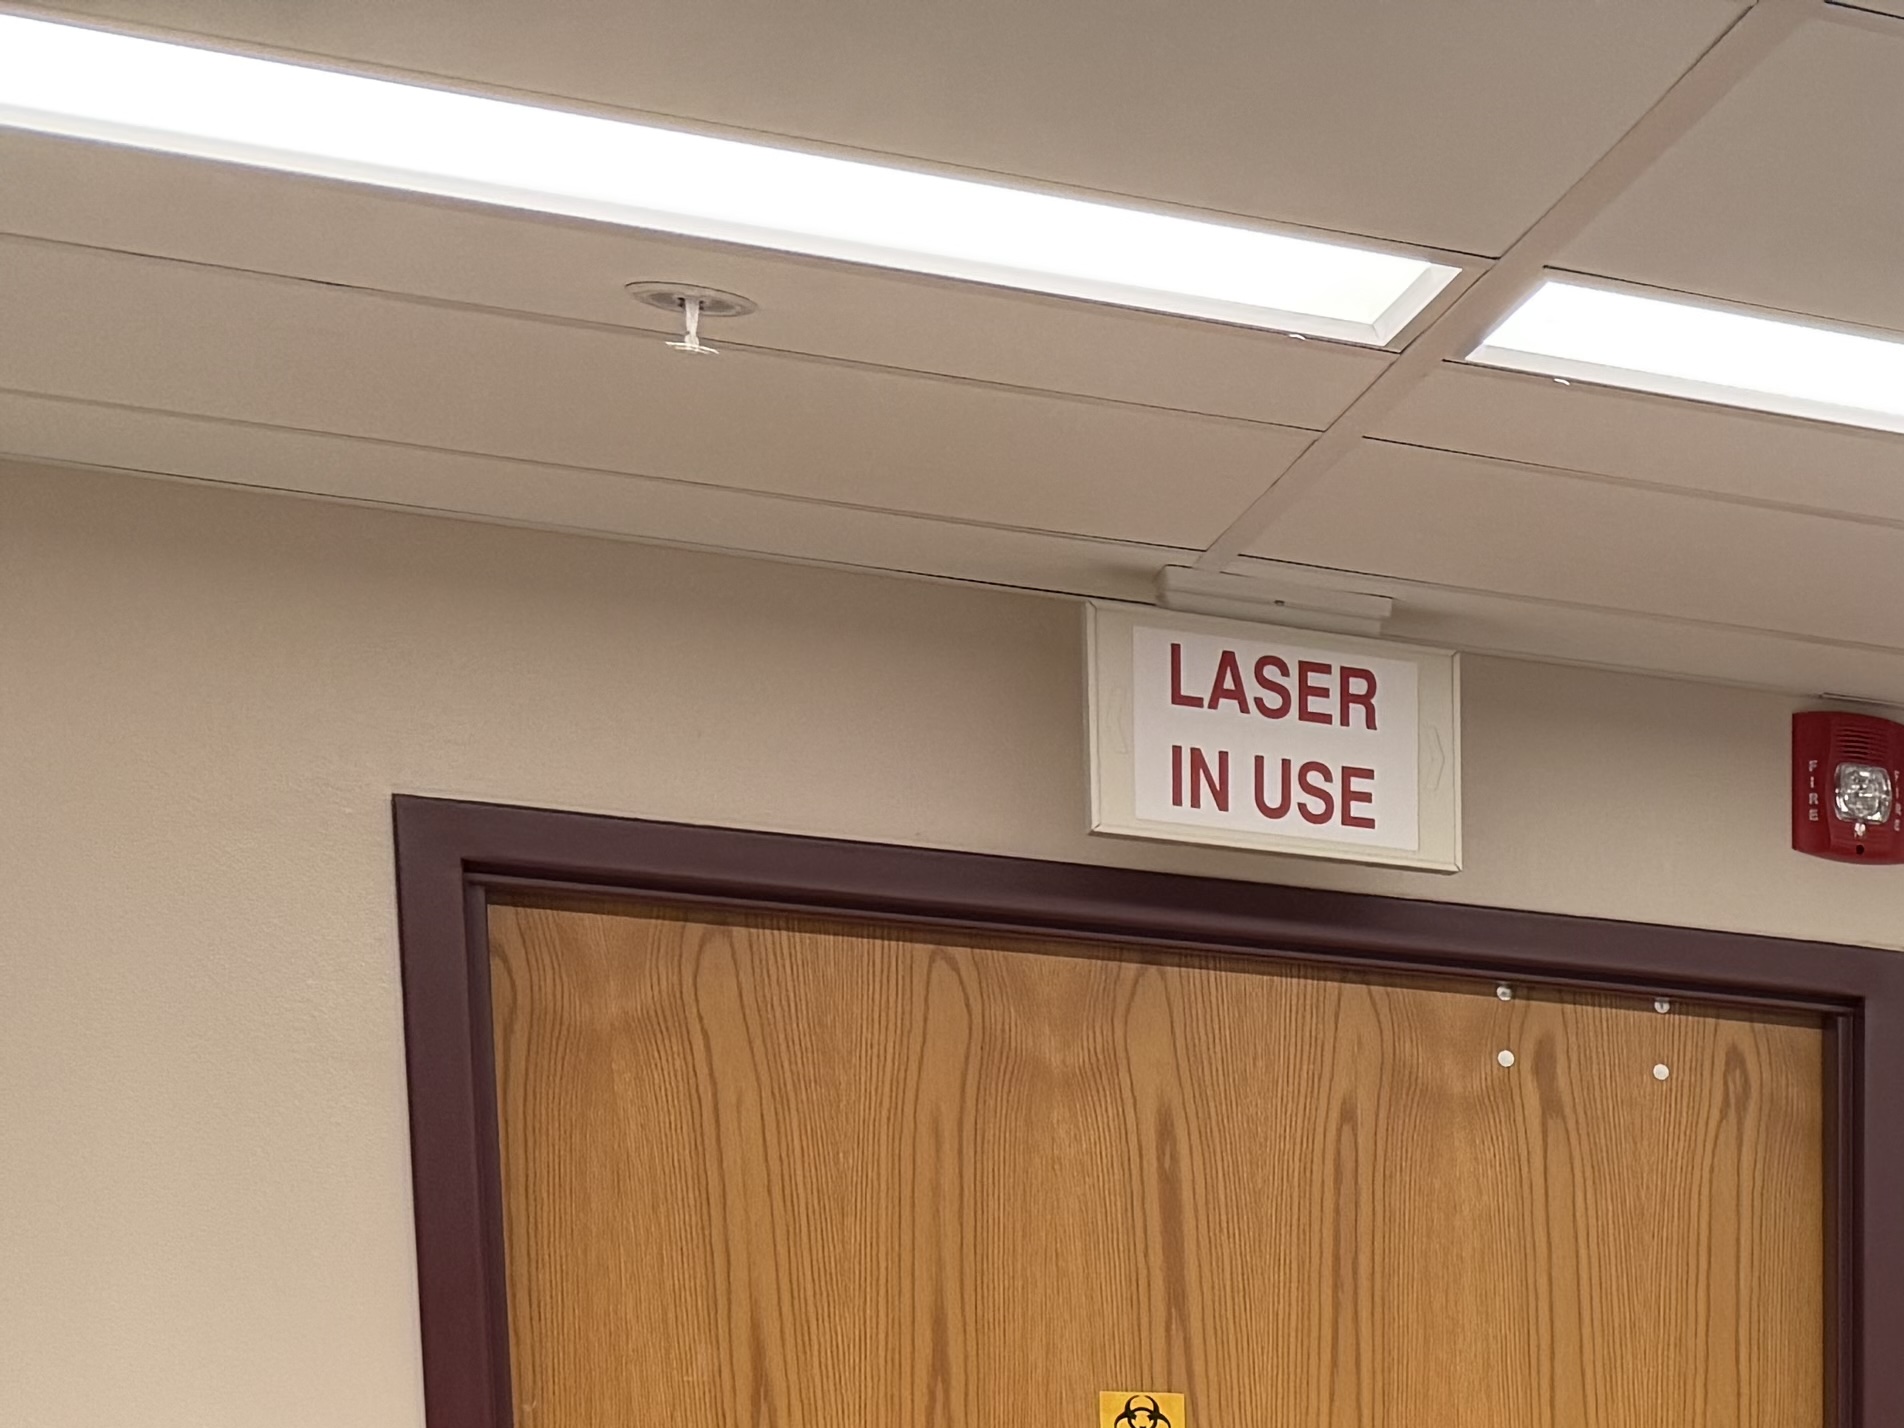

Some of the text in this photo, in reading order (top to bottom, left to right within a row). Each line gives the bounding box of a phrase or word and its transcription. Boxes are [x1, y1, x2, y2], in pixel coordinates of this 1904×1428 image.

[1169, 642, 1379, 731] LASER
[1171, 744, 1376, 830] IN USE
[1808, 759, 1819, 822] FIRE
